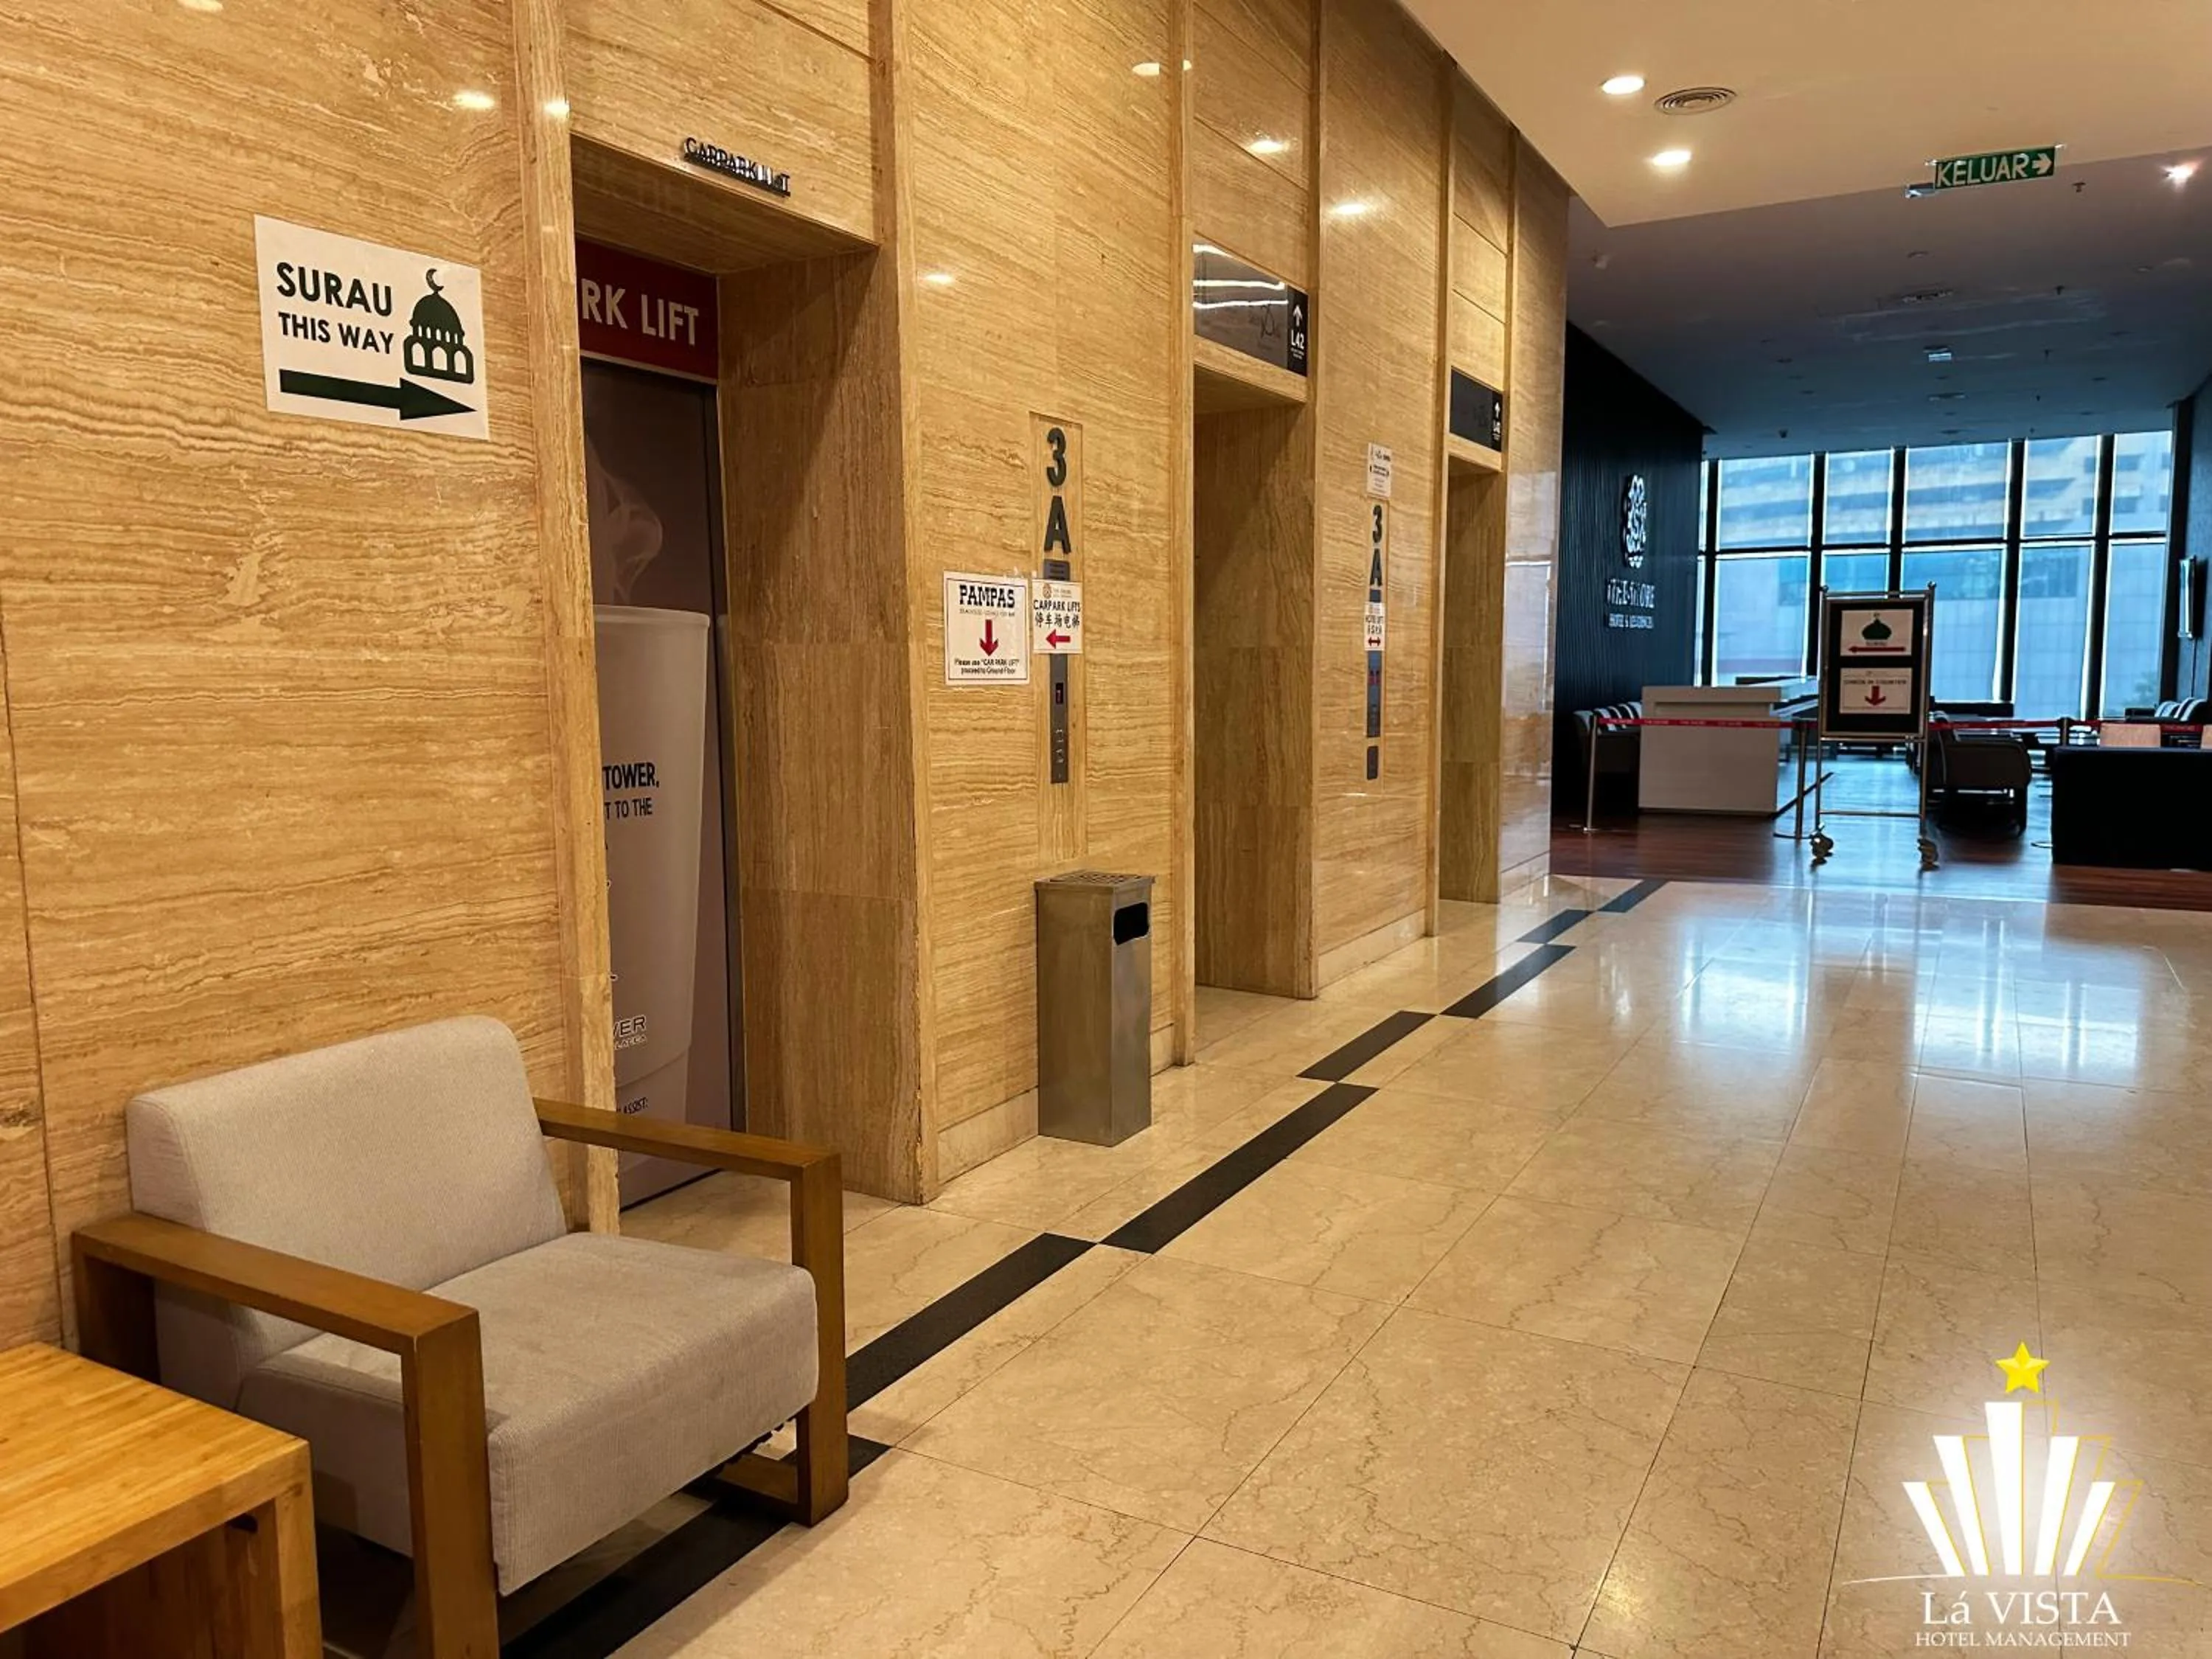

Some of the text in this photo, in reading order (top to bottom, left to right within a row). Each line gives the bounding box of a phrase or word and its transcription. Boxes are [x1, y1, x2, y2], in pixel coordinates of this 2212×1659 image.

[1937, 153, 2030, 187] KELUAR
[276, 262, 393, 316] SURAU
[279, 312, 394, 355] THIS WAY
[641, 293, 699, 346] LIFT
[959, 585, 1015, 608] PAMPAS
[1033, 599, 1065, 611] CARPARK
[614, 800, 629, 820] TO
[632, 797, 653, 817] THE
